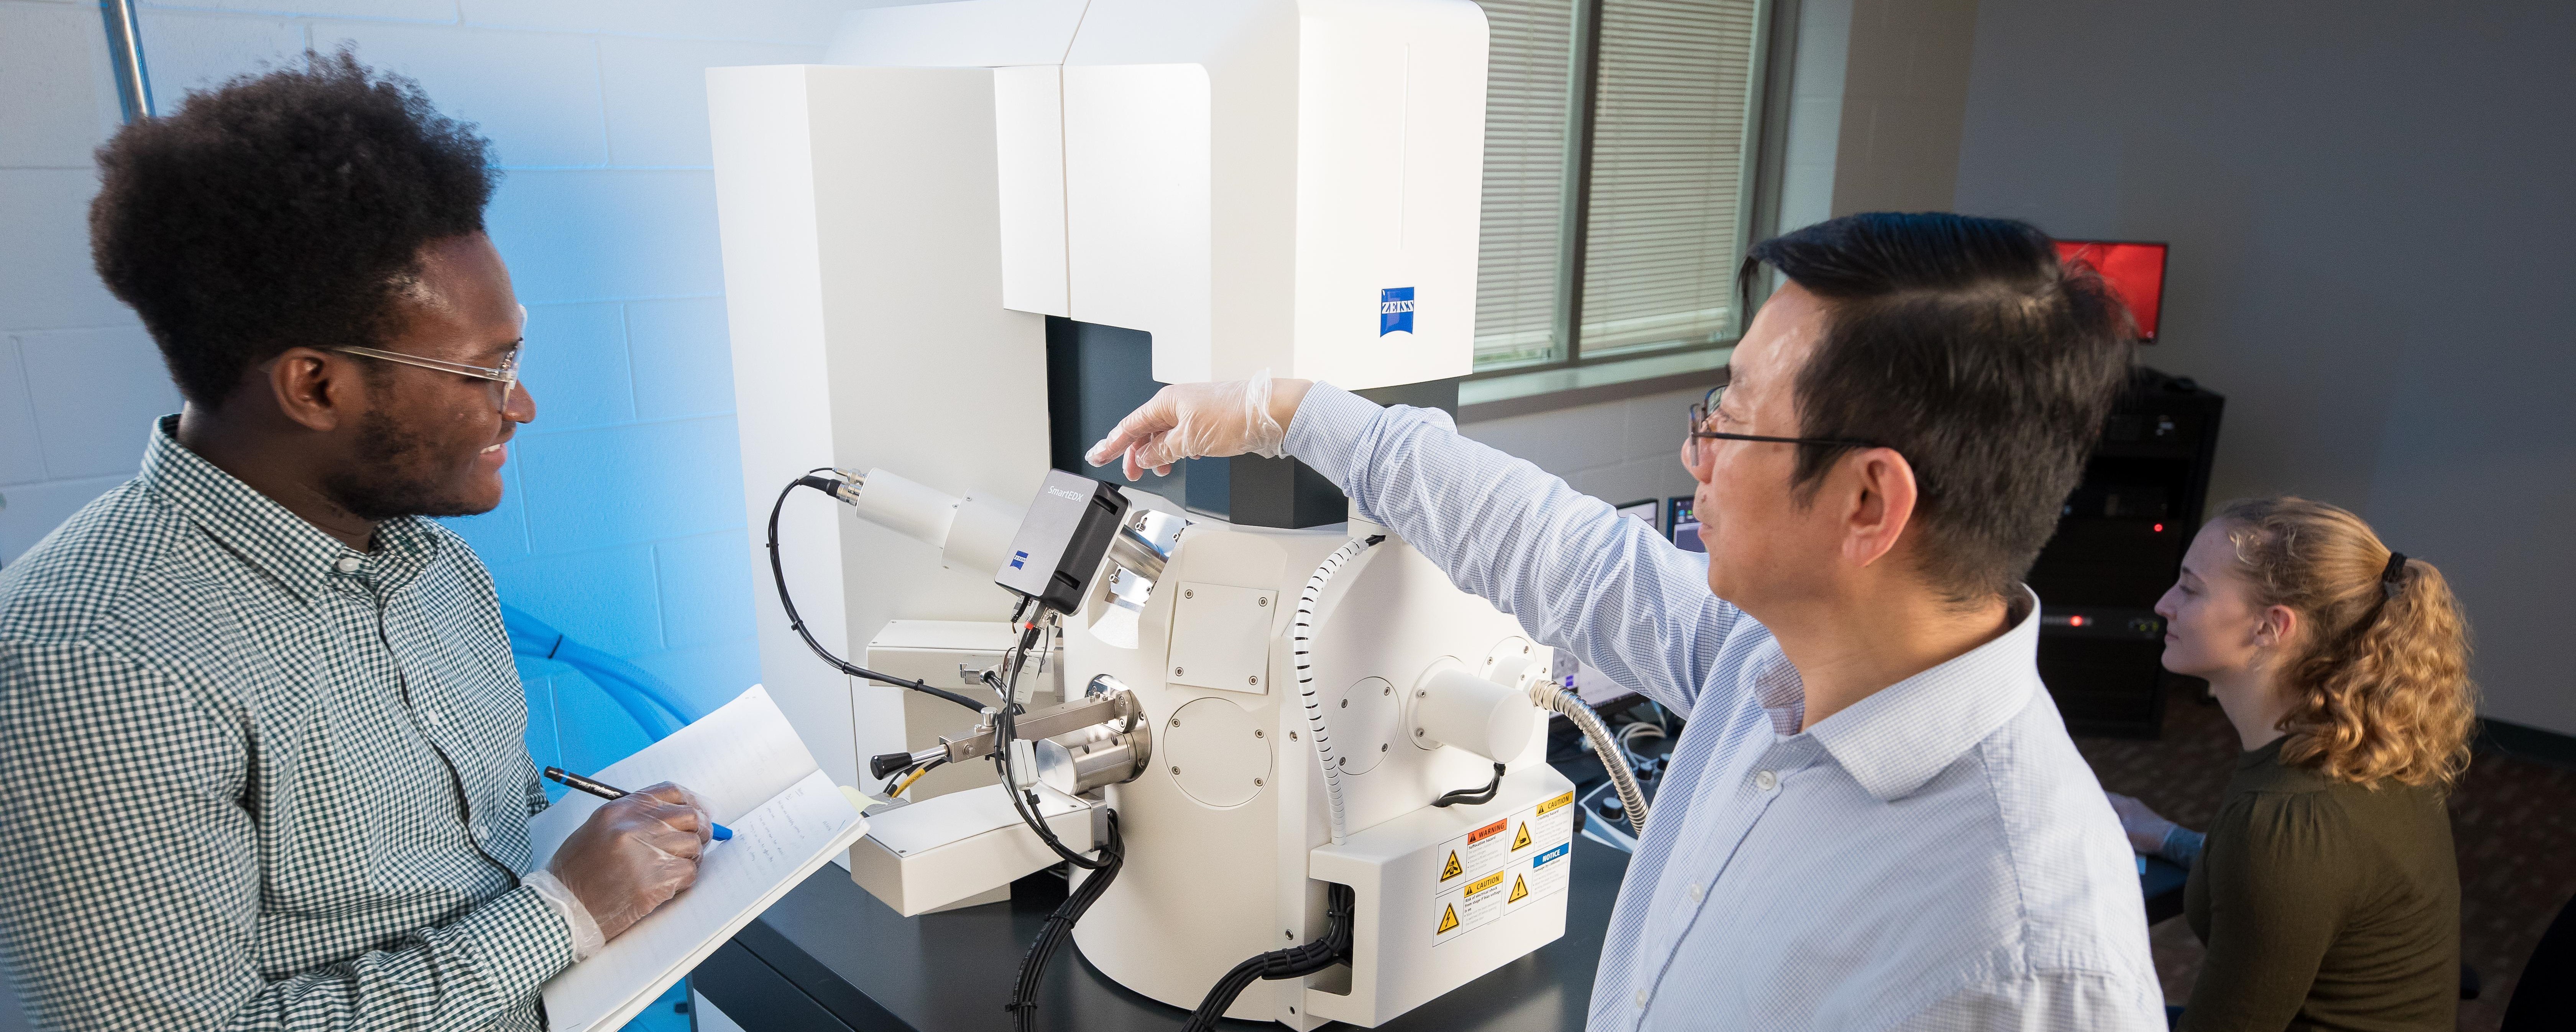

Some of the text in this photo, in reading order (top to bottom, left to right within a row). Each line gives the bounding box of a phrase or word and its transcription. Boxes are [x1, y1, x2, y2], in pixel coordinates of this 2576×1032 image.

[1382, 300, 1414, 314] ZEISS
[1048, 486, 1084, 502] SmartEDX
[1014, 555, 1027, 563] ZEISS
[1548, 795, 1569, 809] CAUTION
[1479, 823, 1505, 838] WARNING
[1469, 841, 1485, 850] Suffocation
[1542, 849, 1560, 862] NOTICE
[1477, 876, 1499, 890] CAUTION
